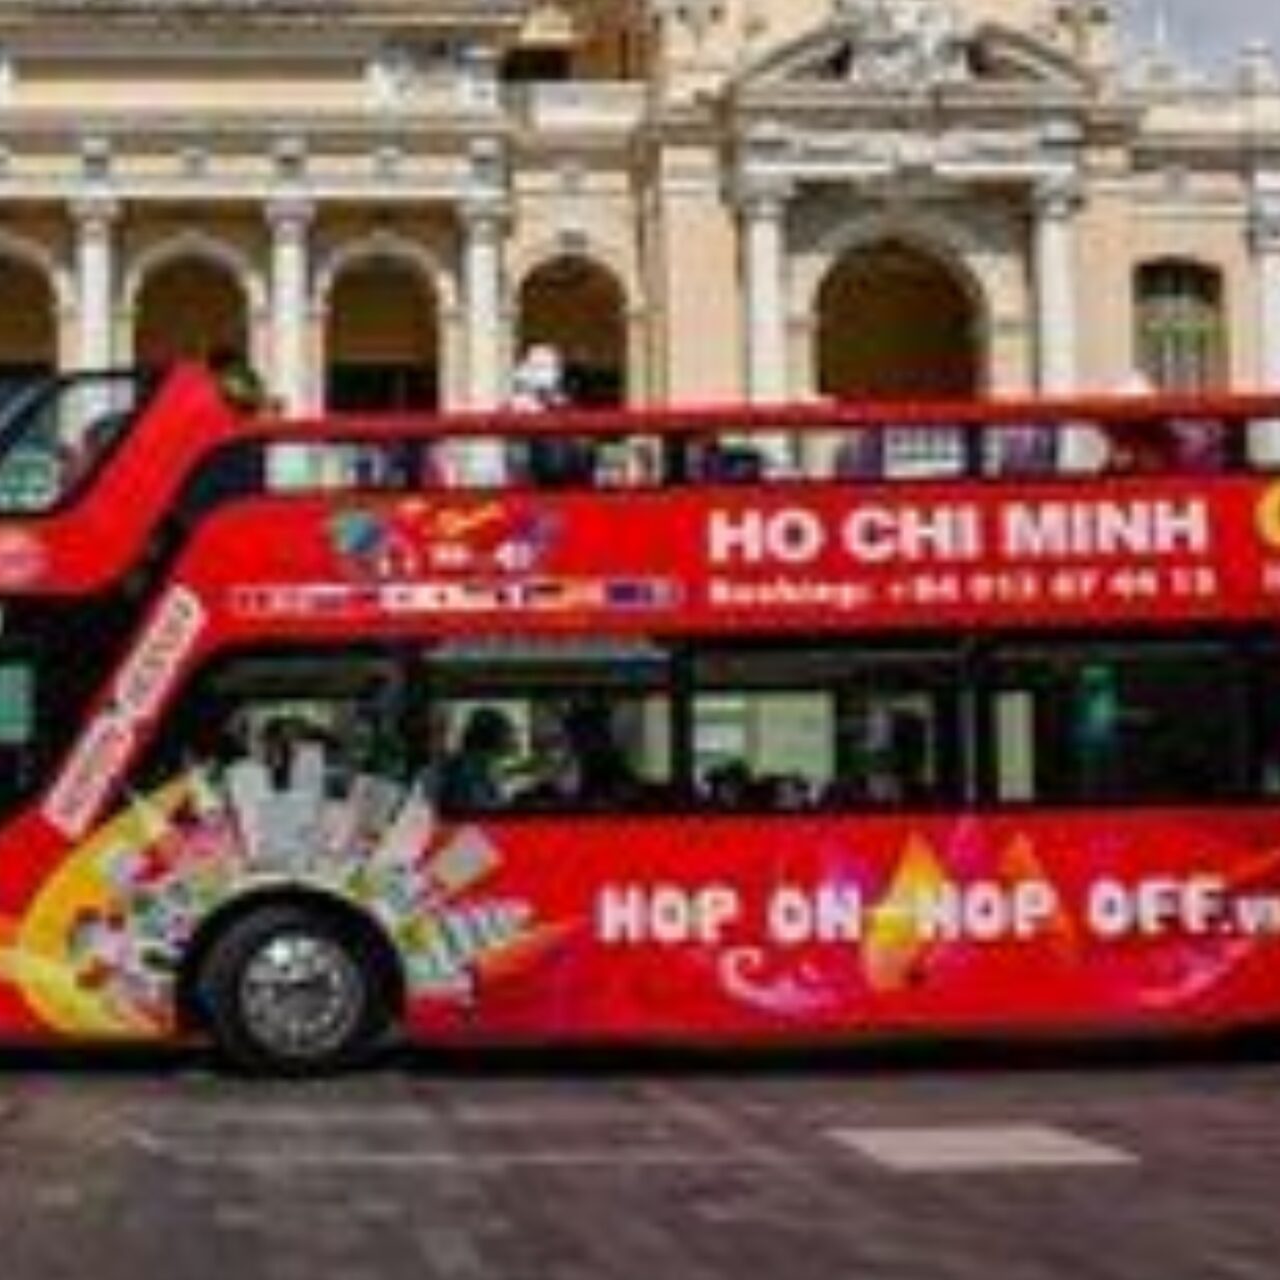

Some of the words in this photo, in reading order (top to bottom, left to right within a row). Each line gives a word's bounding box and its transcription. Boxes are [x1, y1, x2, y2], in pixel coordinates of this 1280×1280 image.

[708, 509, 824, 562] HO
[841, 506, 982, 561] CHI
[1001, 500, 1209, 555] MINH
[597, 885, 741, 942] HOP
